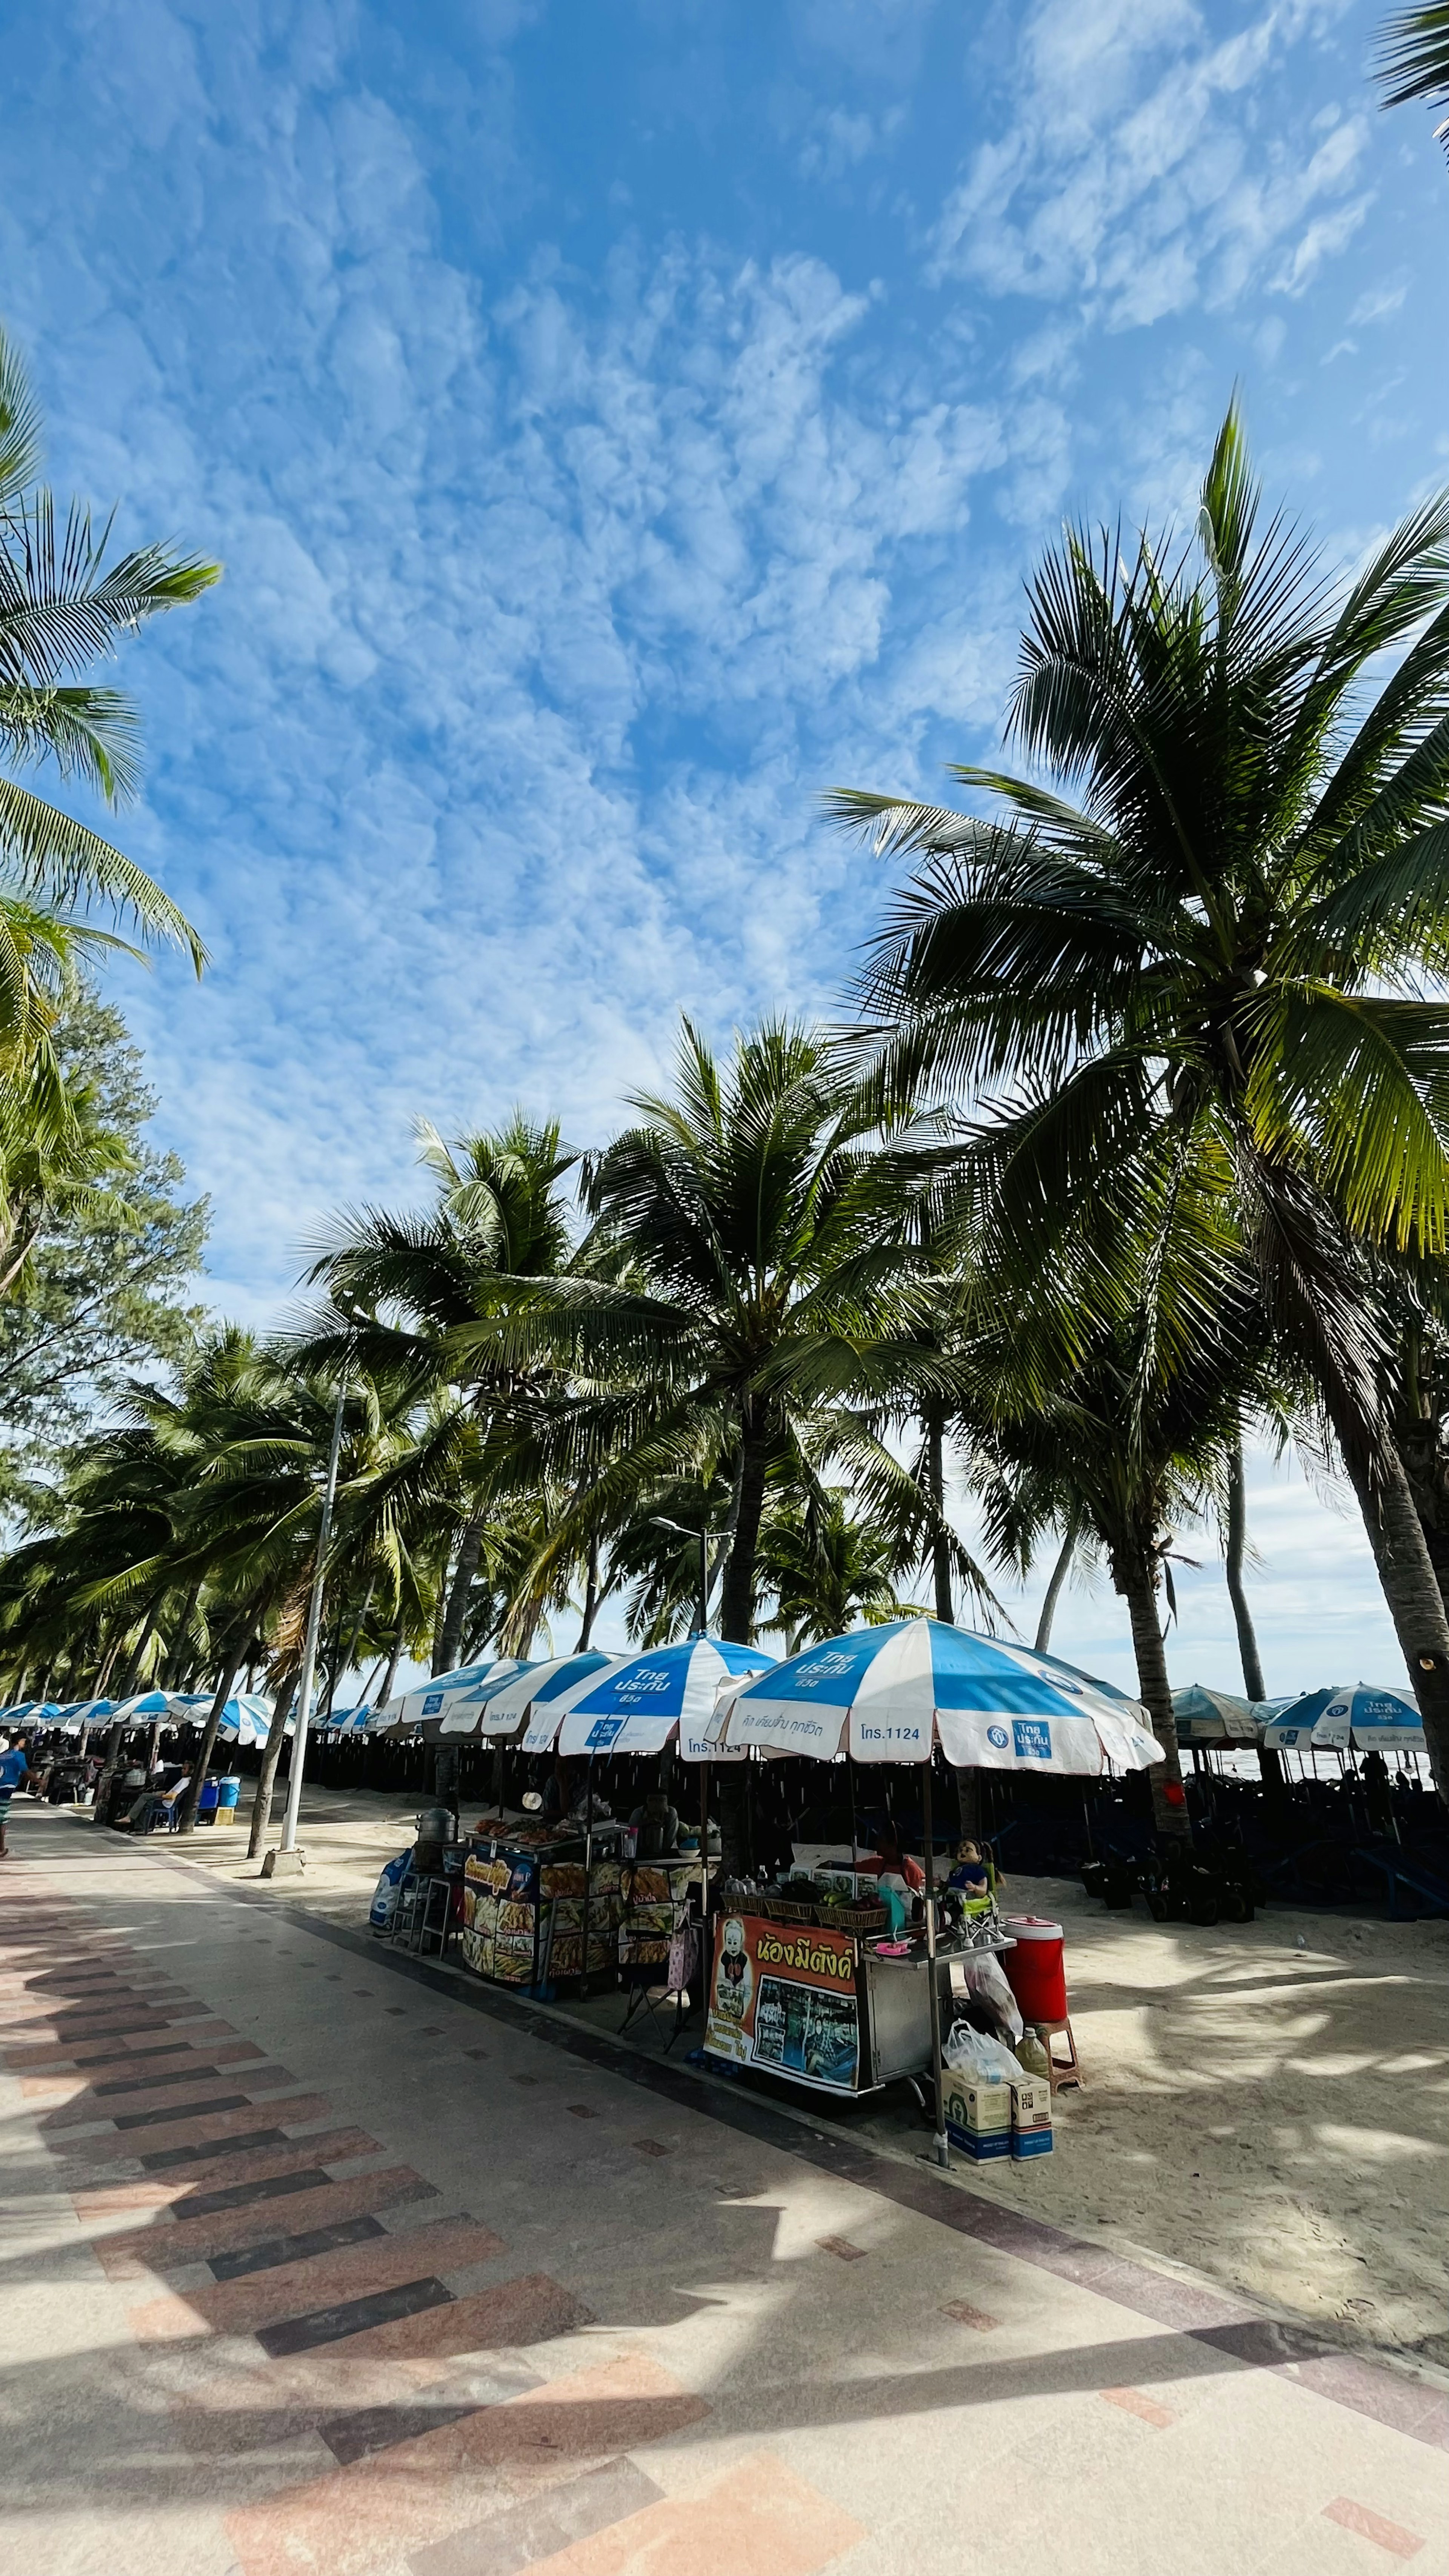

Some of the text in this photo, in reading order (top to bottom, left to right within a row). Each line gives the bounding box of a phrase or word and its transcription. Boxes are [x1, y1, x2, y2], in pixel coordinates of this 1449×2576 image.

[820, 1651, 859, 1663] ไทย
[795, 1662, 855, 1674] ประกัน
[635, 1669, 669, 1680] ไทย
[614, 1679, 671, 1691] ประกัน
[861, 1724, 920, 1740] โทร.1124
[1018, 1722, 1040, 1734] ไทย
[1017, 1734, 1049, 1746] ประกัน
[757, 1933, 853, 1979] น้องมีตังค์
